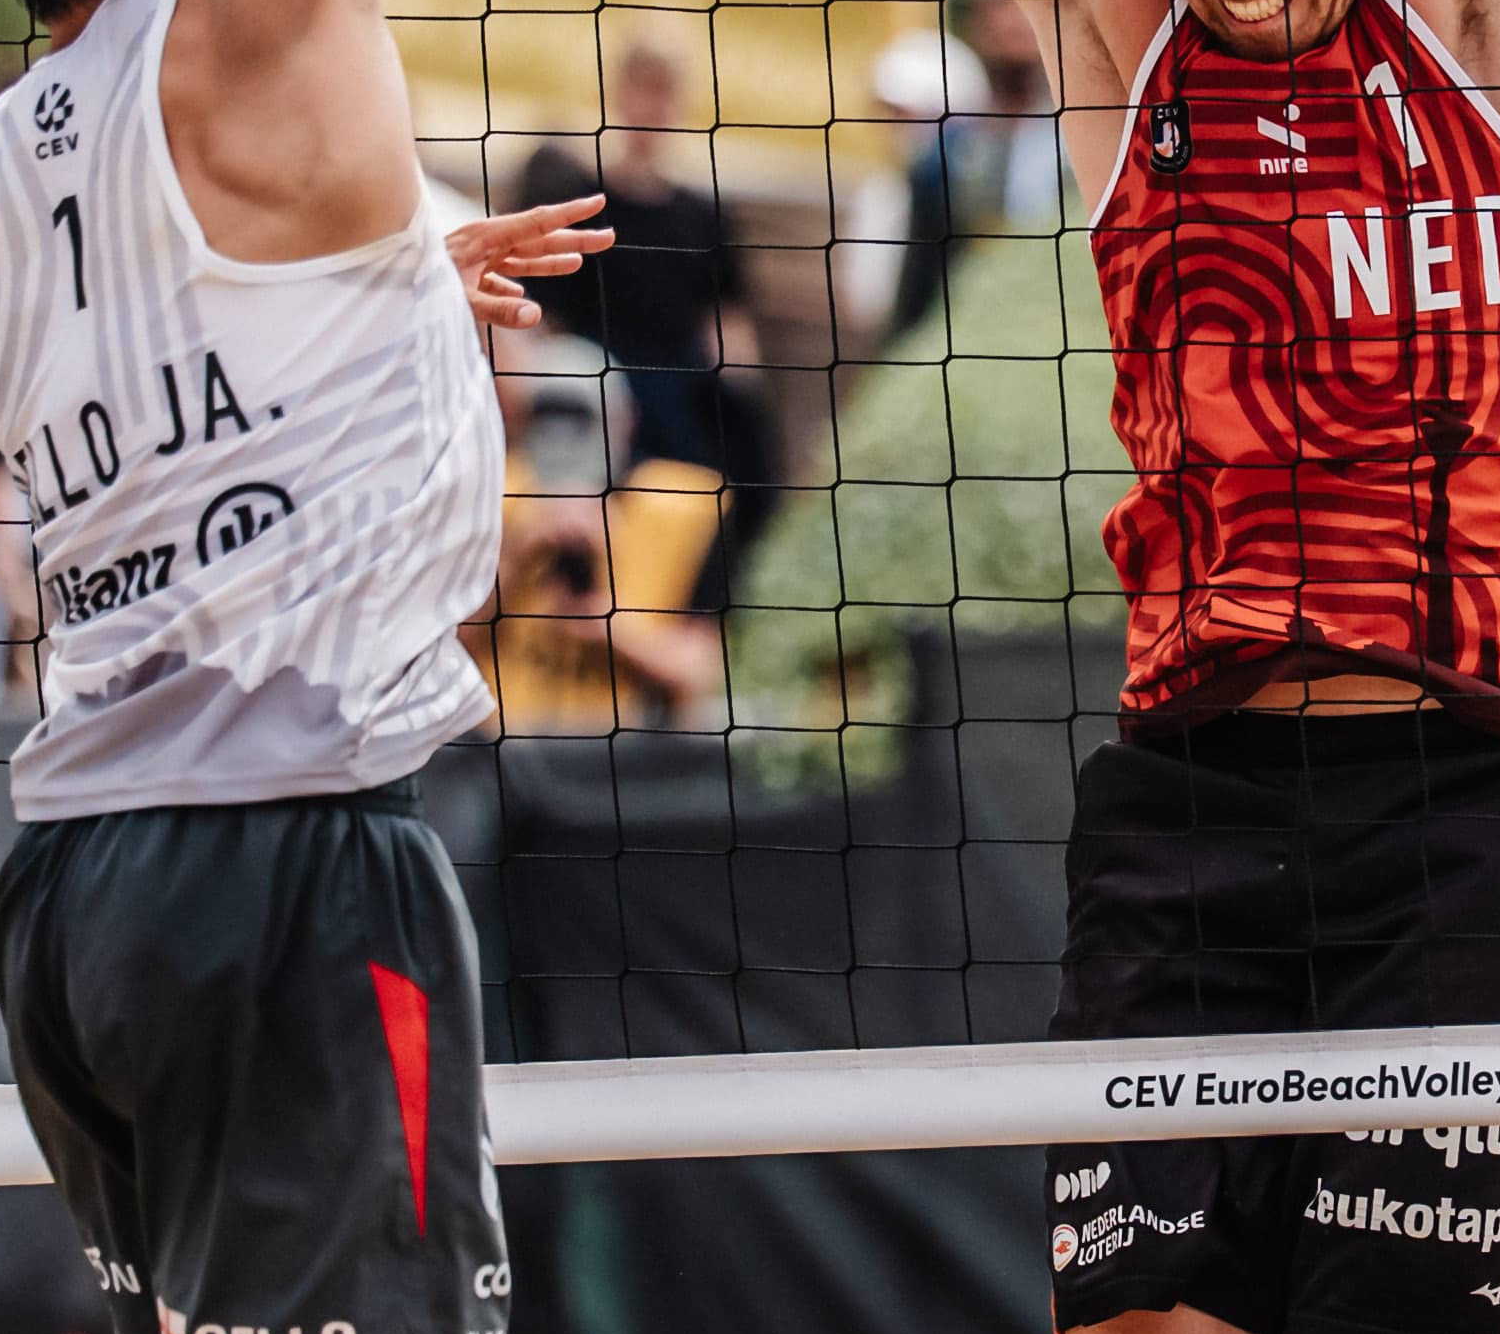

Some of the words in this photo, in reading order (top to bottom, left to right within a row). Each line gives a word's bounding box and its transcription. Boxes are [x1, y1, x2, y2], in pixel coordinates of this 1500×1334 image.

[1363, 60, 1428, 169] 1
[34, 132, 80, 161] CEV
[52, 194, 87, 312] 1
[155, 350, 285, 457] JA.
[1104, 1073, 1186, 1109] CEV
[1081, 1204, 1206, 1245] NEDERLANDSE
[1077, 1226, 1135, 1267] LOTERIJ
